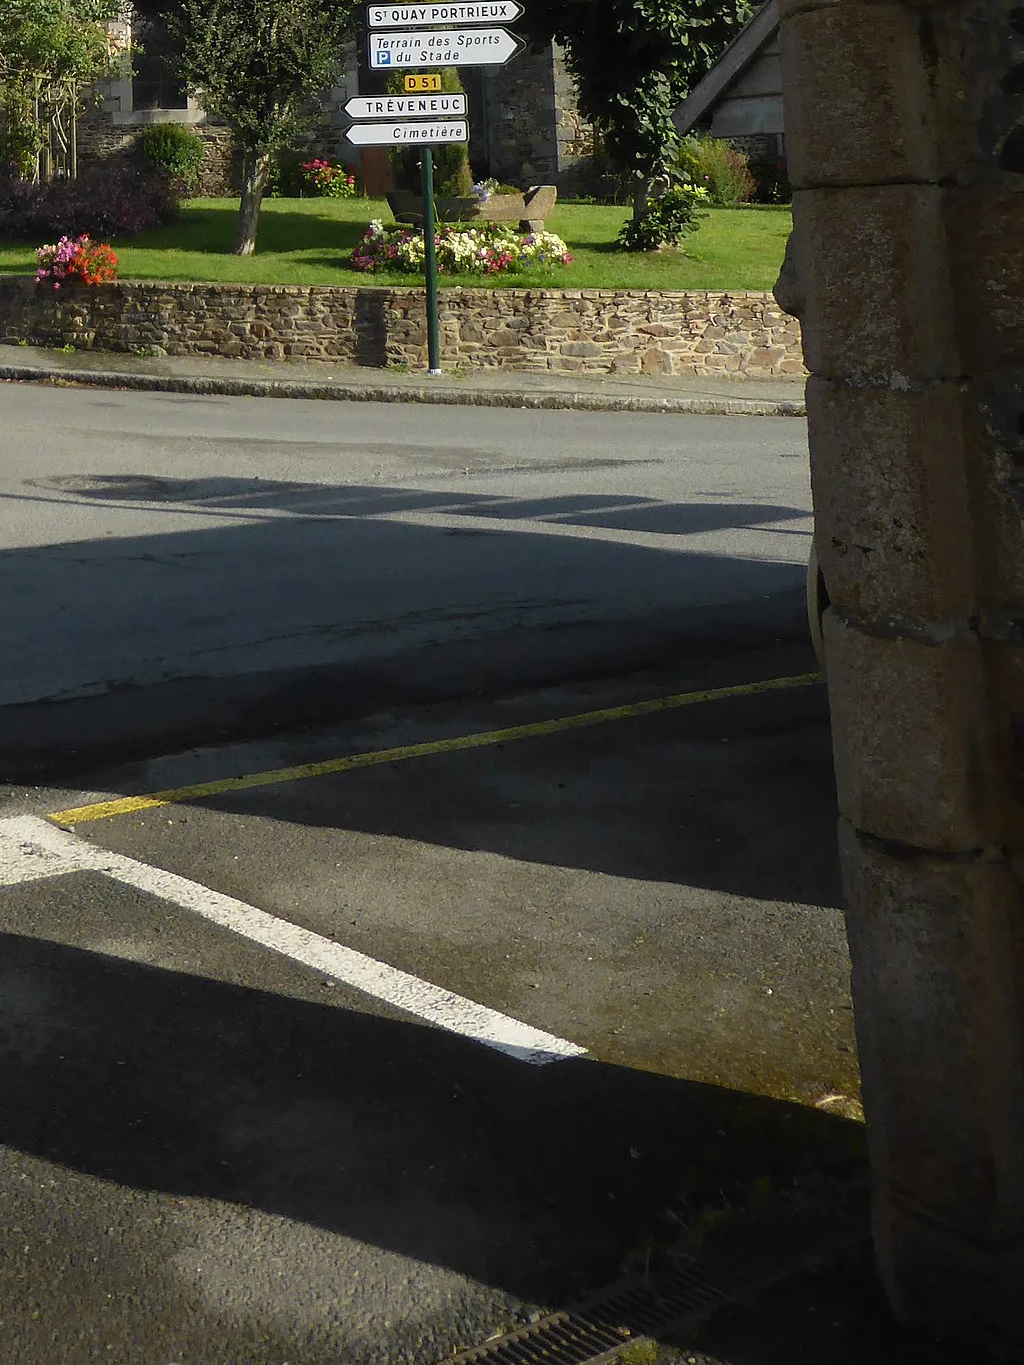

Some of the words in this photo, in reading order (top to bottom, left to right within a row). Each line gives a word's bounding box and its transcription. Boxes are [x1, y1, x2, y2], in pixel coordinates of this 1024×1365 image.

[391, 8, 426, 22] QUAY
[431, 5, 507, 19] PORTRIEUX
[377, 36, 421, 49] Terrain
[428, 36, 450, 47] des
[457, 34, 500, 48] Sports
[396, 51, 412, 63] du
[420, 49, 460, 62] Stade
[408, 78, 416, 89] D
[421, 77, 437, 88] 51
[366, 98, 460, 113] TRÉVENEUC
[393, 126, 462, 139] Cimetière
